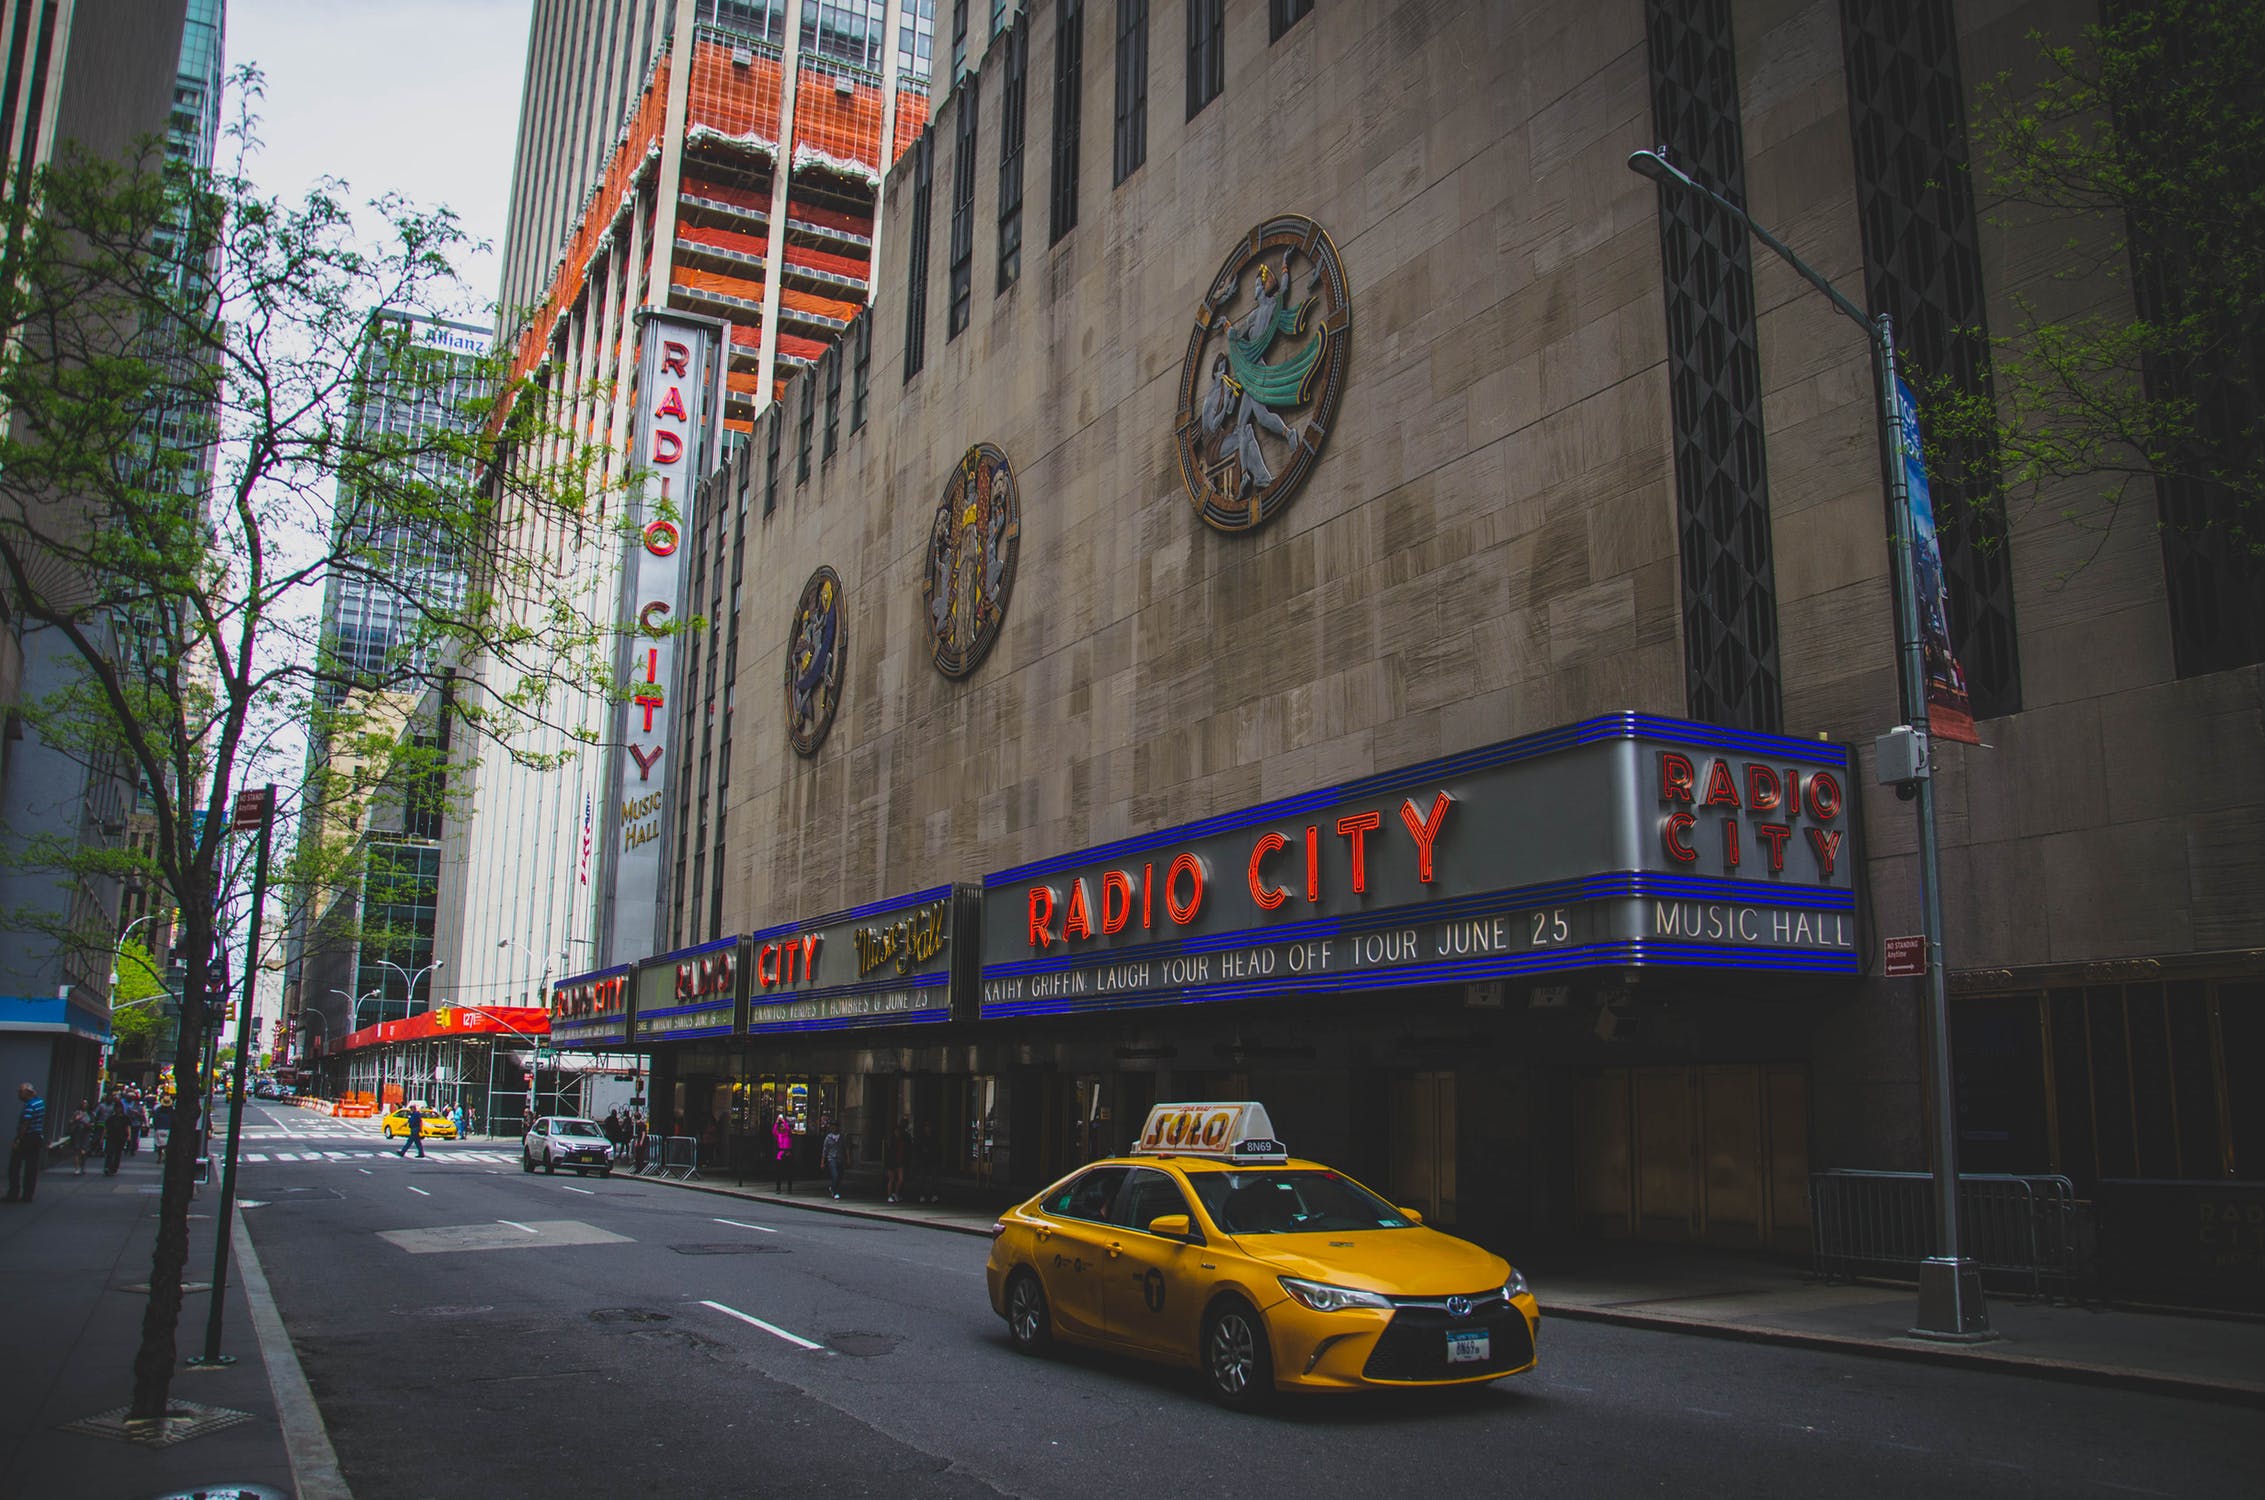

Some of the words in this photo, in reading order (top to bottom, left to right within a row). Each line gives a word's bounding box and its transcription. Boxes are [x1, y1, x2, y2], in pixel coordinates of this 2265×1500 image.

[425, 328, 485, 352] Allianz
[643, 340, 690, 557] RADIO
[628, 600, 671, 781] CITY
[239, 794, 246, 802] NO
[1658, 752, 1841, 820] RADIO
[621, 791, 662, 827] MUSIC
[625, 820, 659, 853] HALL
[1662, 812, 1841, 875] CITY
[1029, 852, 1205, 948] RADIO
[1249, 790, 1452, 910] CITY
[1656, 901, 1758, 941] MUSIC
[1773, 911, 1851, 946] HALL
[758, 932, 821, 988] CITY
[854, 922, 904, 978] Music
[896, 900, 946, 975] Hall
[984, 978, 1023, 1002] KATHY
[1097, 962, 1149, 991] LAUGH
[1161, 955, 1209, 984] YOUR
[1222, 948, 1276, 979] HEAD
[1289, 940, 1333, 972] OFF
[1352, 929, 1417, 965] TOUR
[1438, 917, 1507, 956] JUNE
[1533, 909, 1568, 945] 25
[1887, 942, 1894, 950] NO
[1895, 940, 1918, 949] STANDING
[1888, 951, 1907, 959] Anytime
[675, 952, 733, 1000] RADIO
[886, 991, 908, 1010] JUNE
[915, 989, 928, 1008] 23
[1146, 1112, 1230, 1146] SOLO
[1246, 1141, 1272, 1152] 8N69
